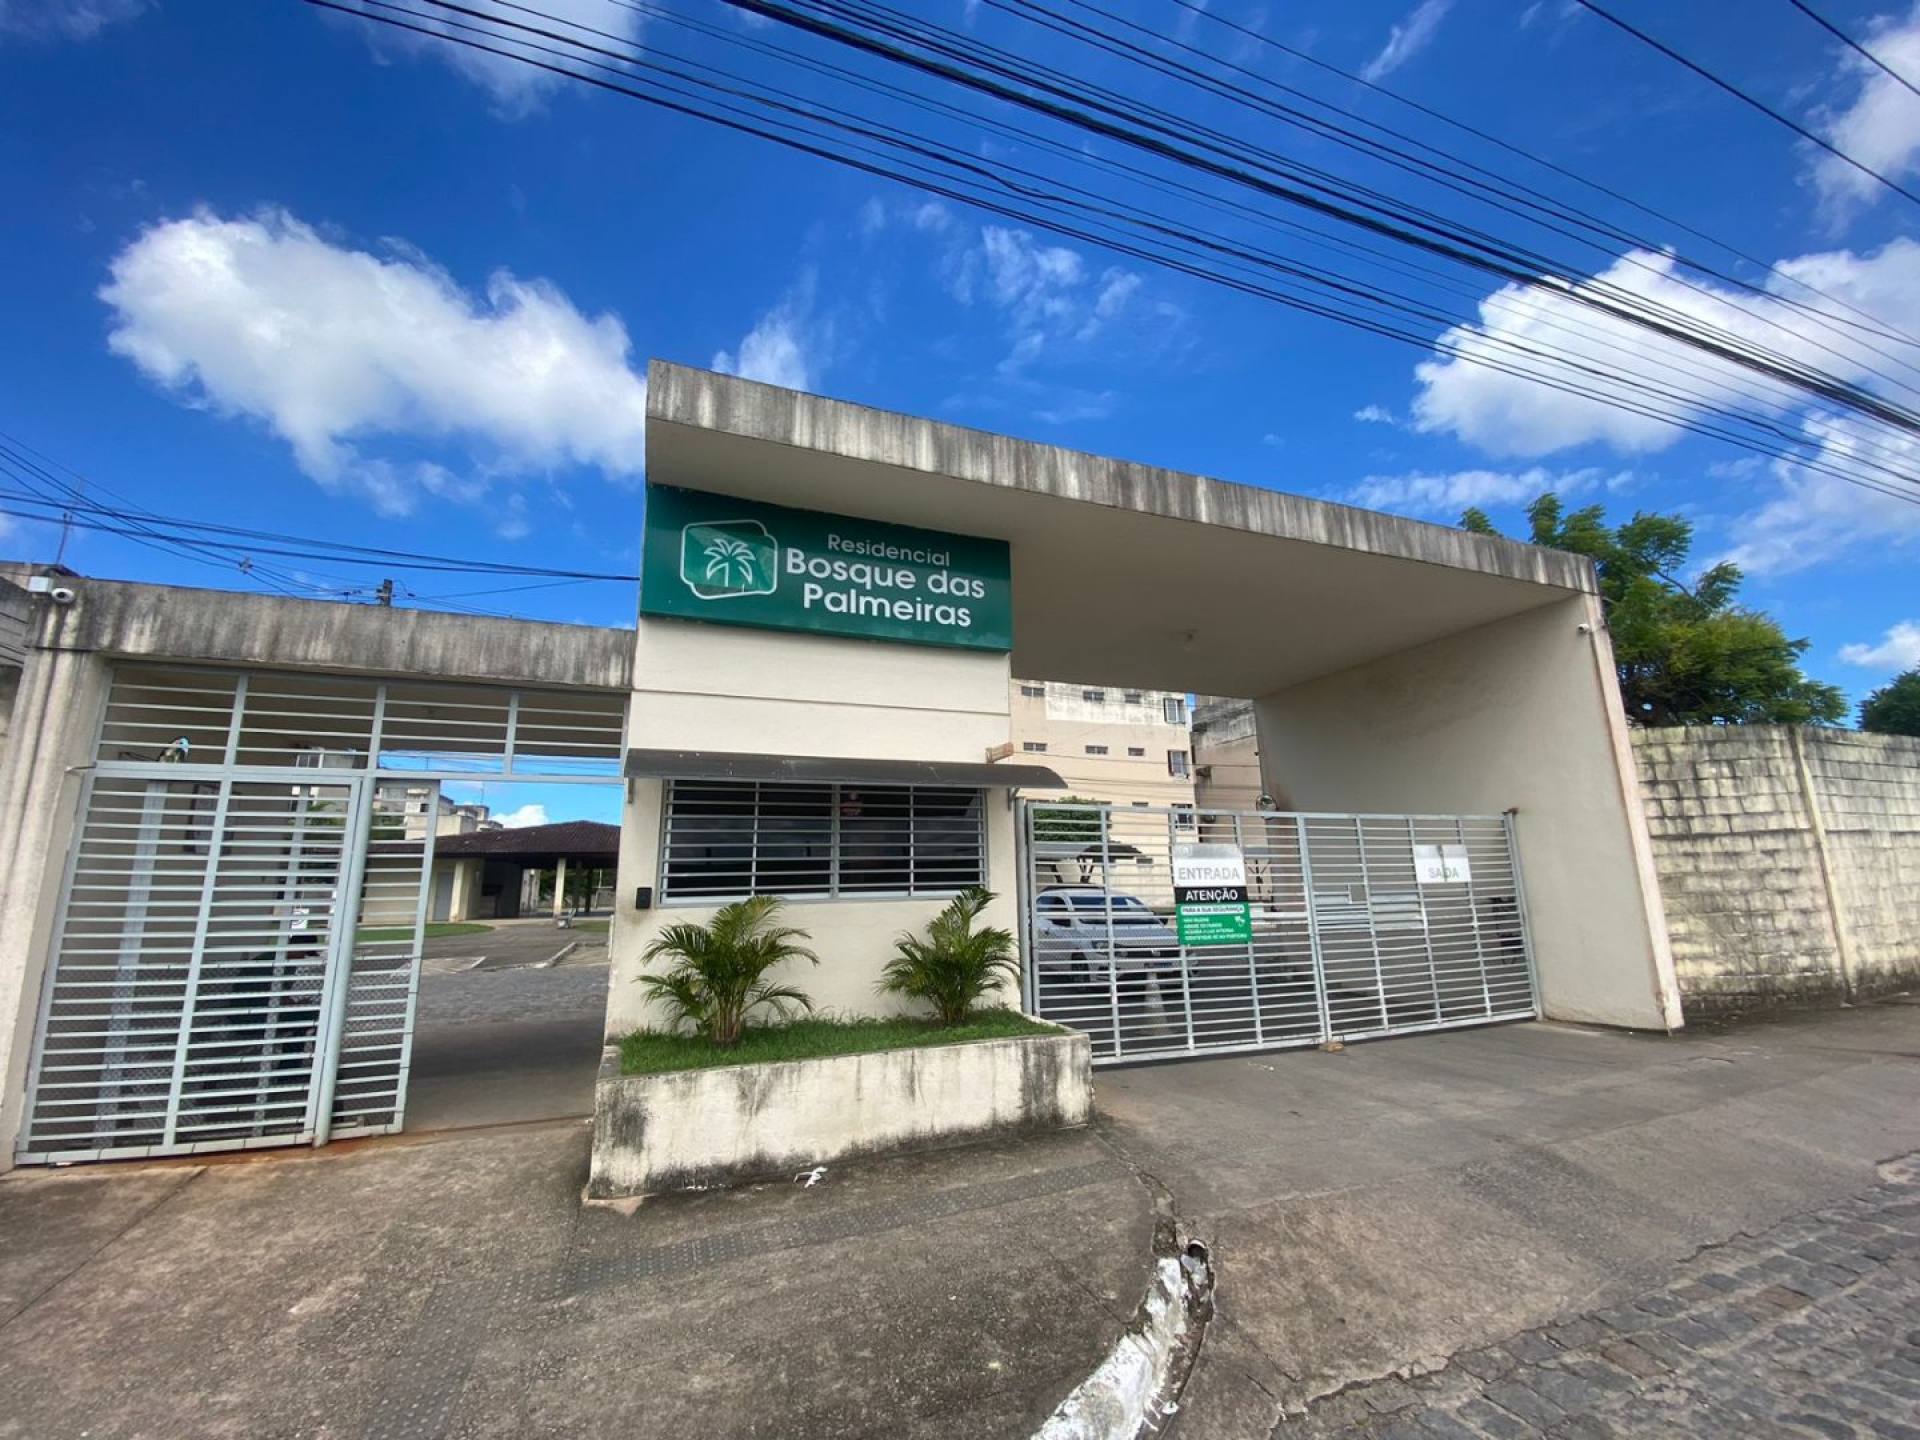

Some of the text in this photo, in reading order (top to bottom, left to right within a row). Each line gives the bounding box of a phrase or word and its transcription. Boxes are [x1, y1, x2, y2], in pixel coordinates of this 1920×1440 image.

[827, 534, 950, 567] Residencial
[786, 548, 985, 599] Bosque das
[803, 583, 971, 627] Palmeiras
[1178, 867, 1241, 880] ENTRADA
[1427, 866, 1460, 879] SADA
[1185, 887, 1239, 903] ATENÇÃO
